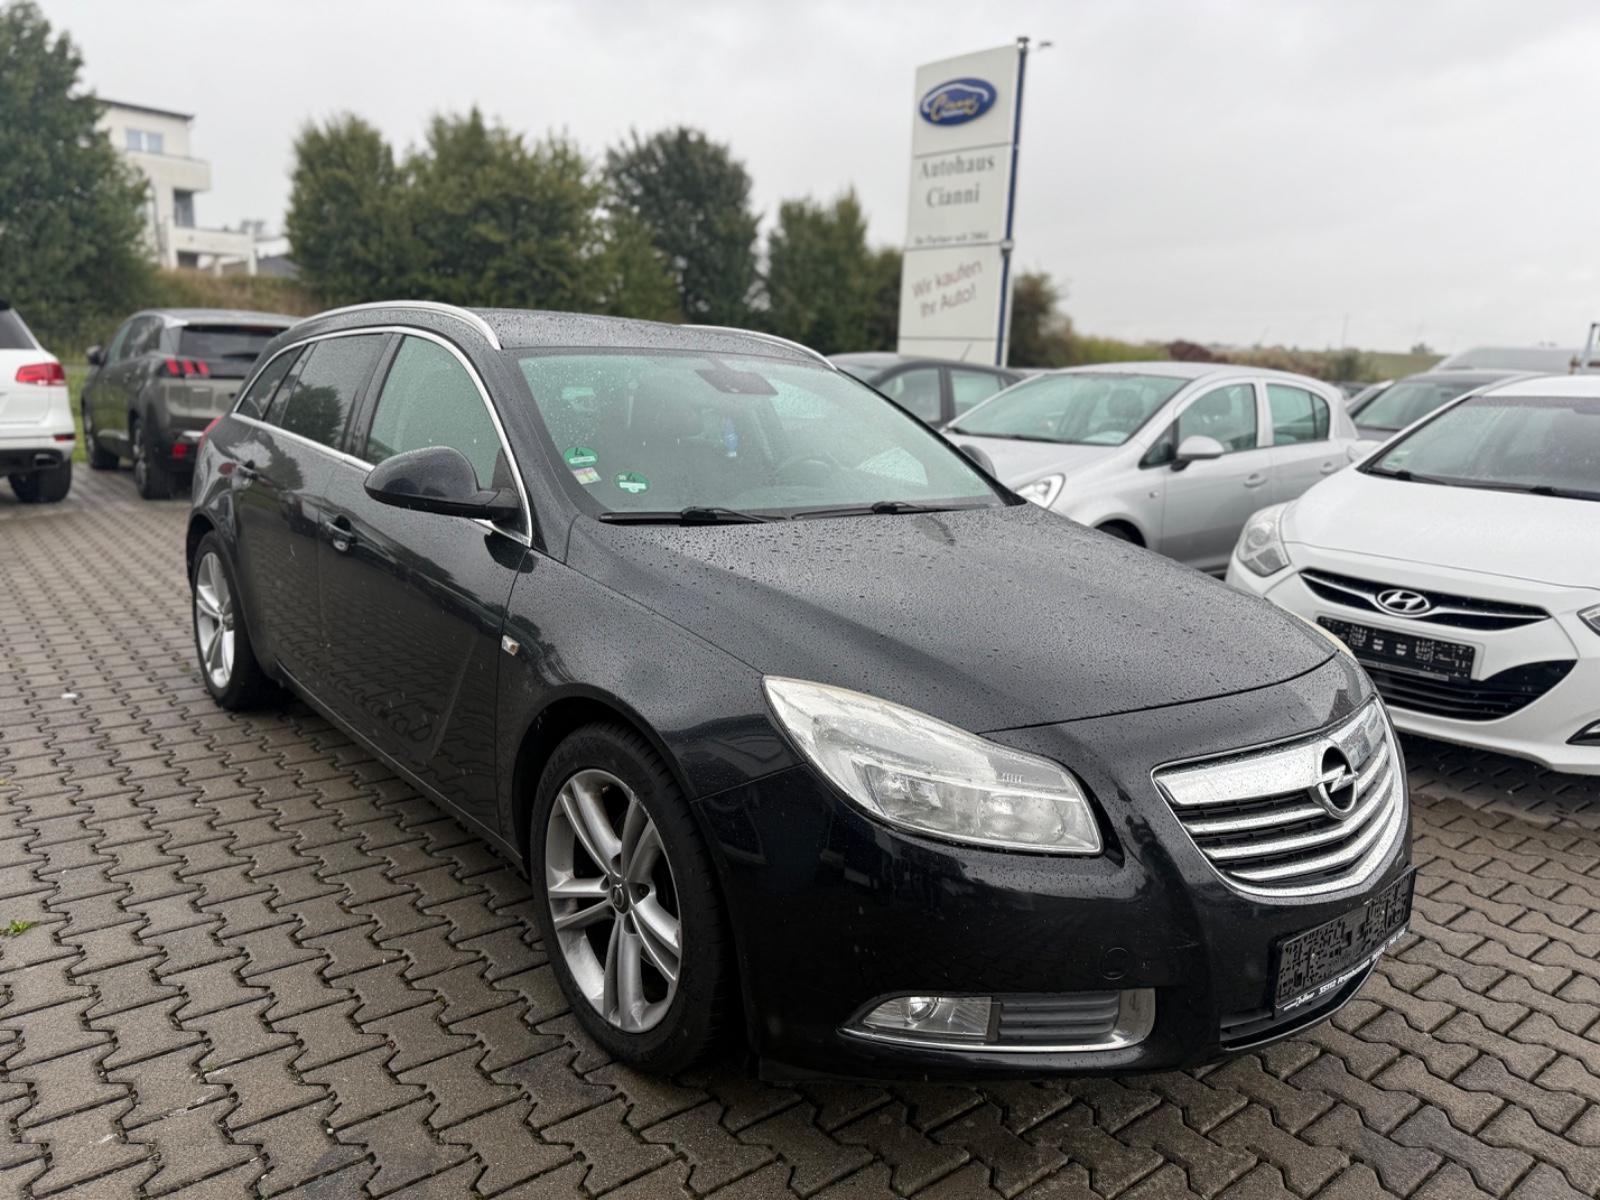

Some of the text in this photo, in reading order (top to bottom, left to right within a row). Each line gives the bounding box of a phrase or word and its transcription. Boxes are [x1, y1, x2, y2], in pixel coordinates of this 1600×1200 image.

[919, 155, 995, 179] Autohaus
[926, 182, 980, 208] Cianni
[912, 260, 983, 299] Wir kaufen
